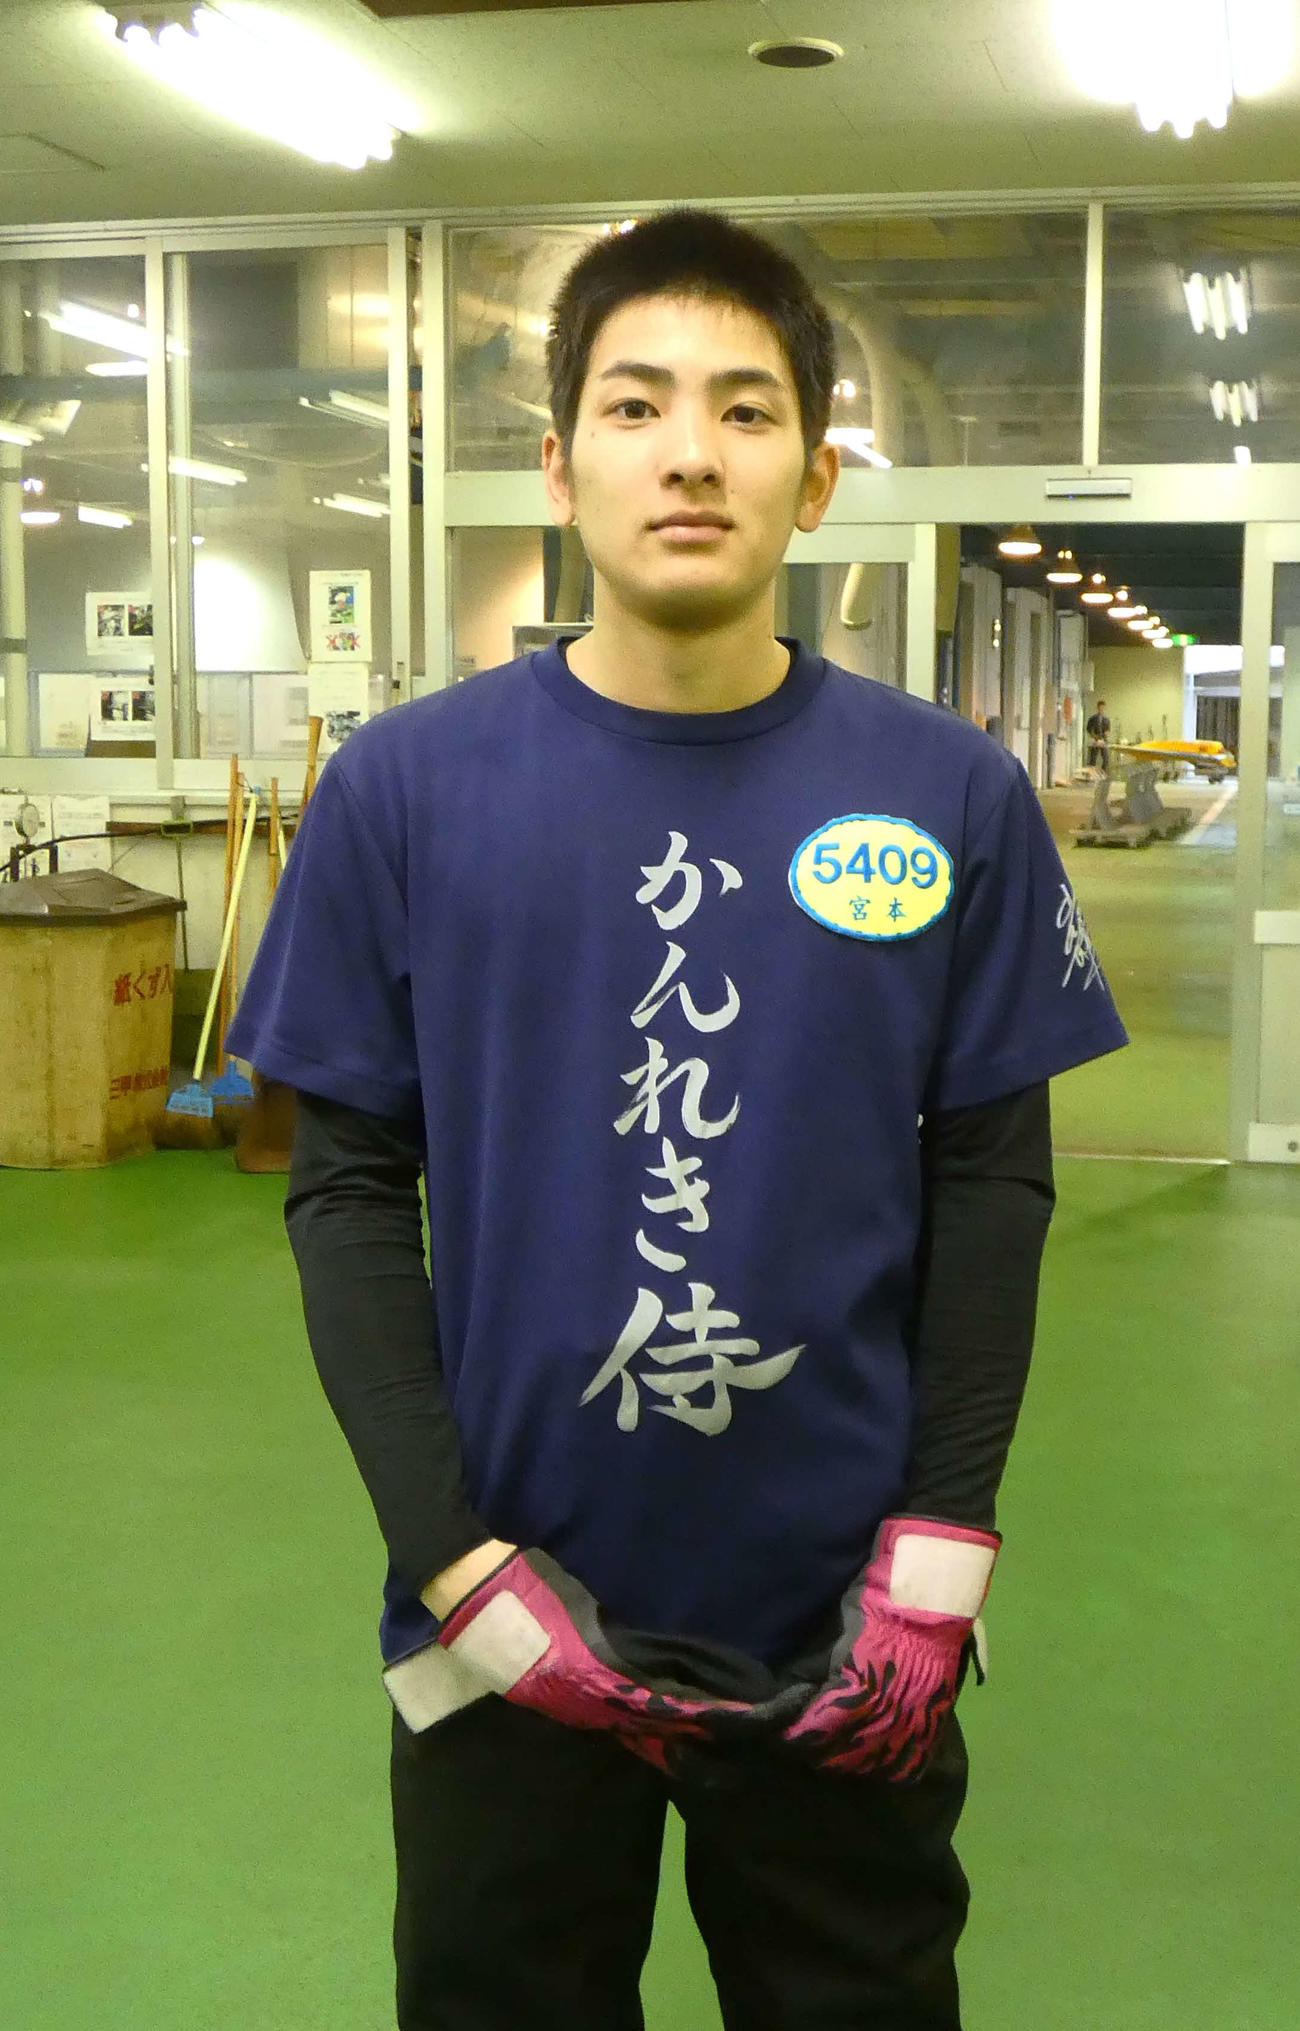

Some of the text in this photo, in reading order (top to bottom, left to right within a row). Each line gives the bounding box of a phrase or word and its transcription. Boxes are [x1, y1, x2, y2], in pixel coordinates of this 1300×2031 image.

[812, 842, 938, 889] 5409
[849, 896, 906, 922] 宮本
[580, 830, 807, 1436] かんれき侍
